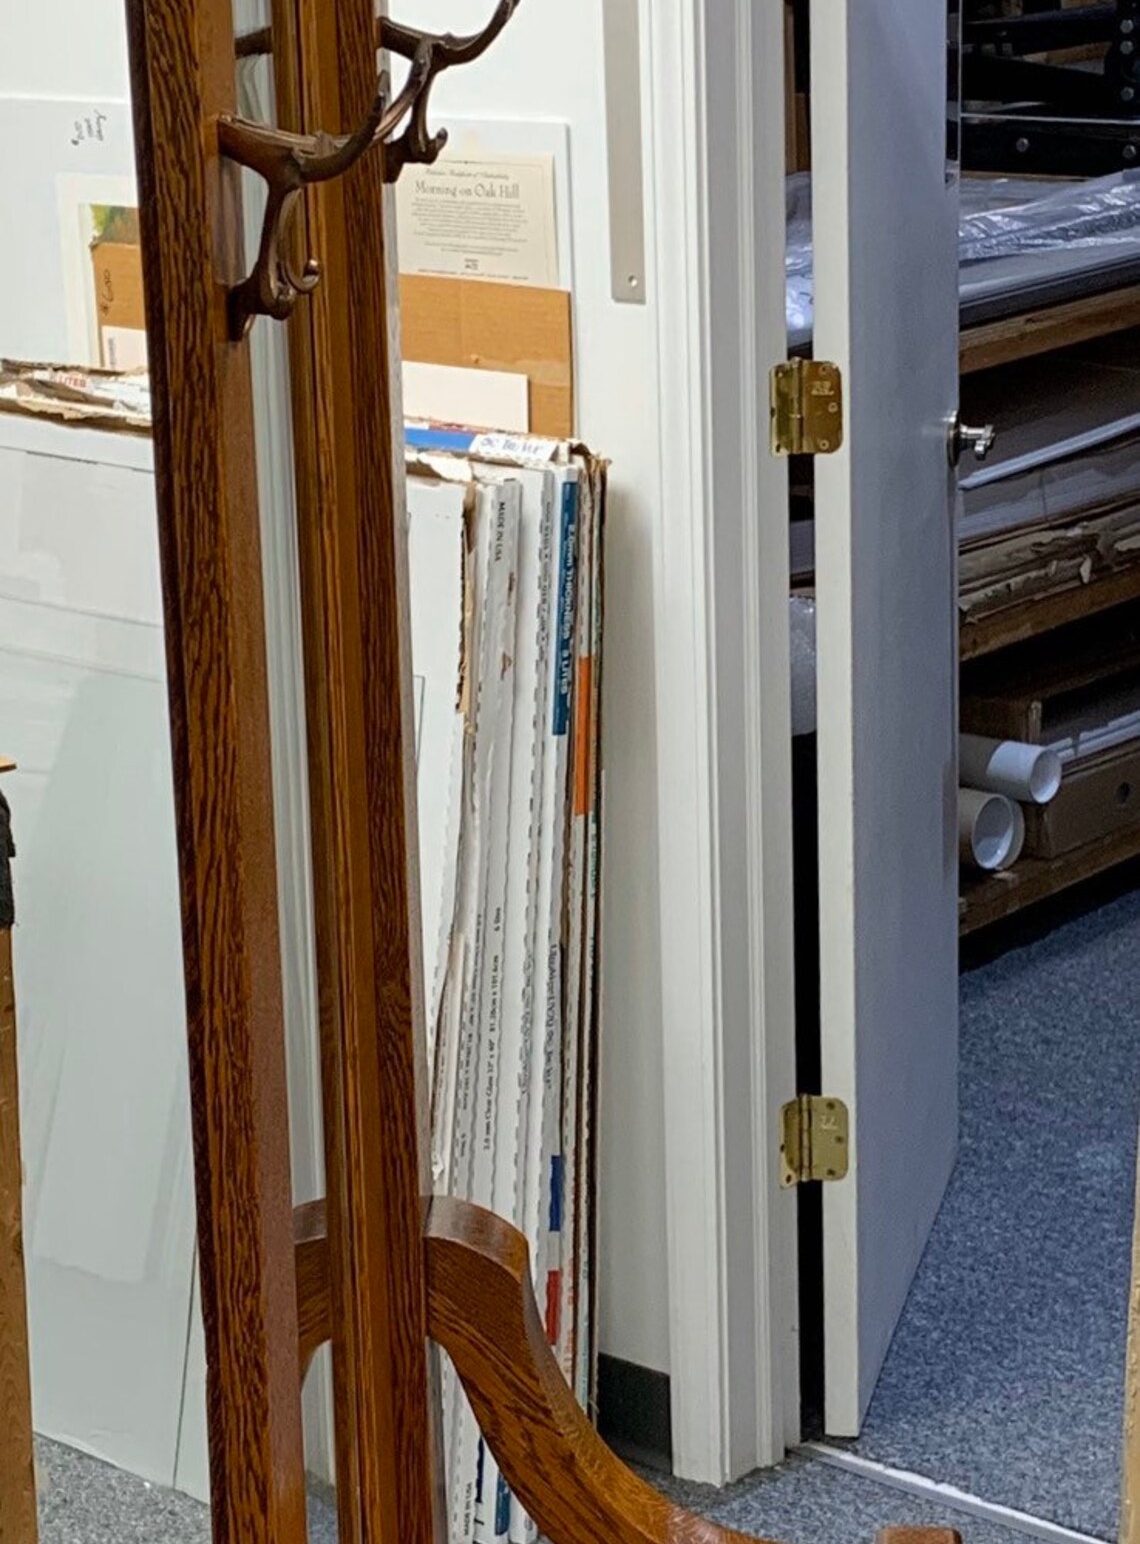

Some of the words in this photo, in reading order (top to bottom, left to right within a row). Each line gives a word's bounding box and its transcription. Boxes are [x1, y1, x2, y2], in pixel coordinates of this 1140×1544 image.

[415, 180, 457, 198] Morning
[459, 186, 472, 196] on
[474, 183, 496, 197] Oak
[499, 184, 520, 199] Hill
[496, 501, 506, 529] MADE
[495, 530, 504, 541] IN
[494, 543, 504, 562] USA
[563, 567, 575, 640] THICKNESS
